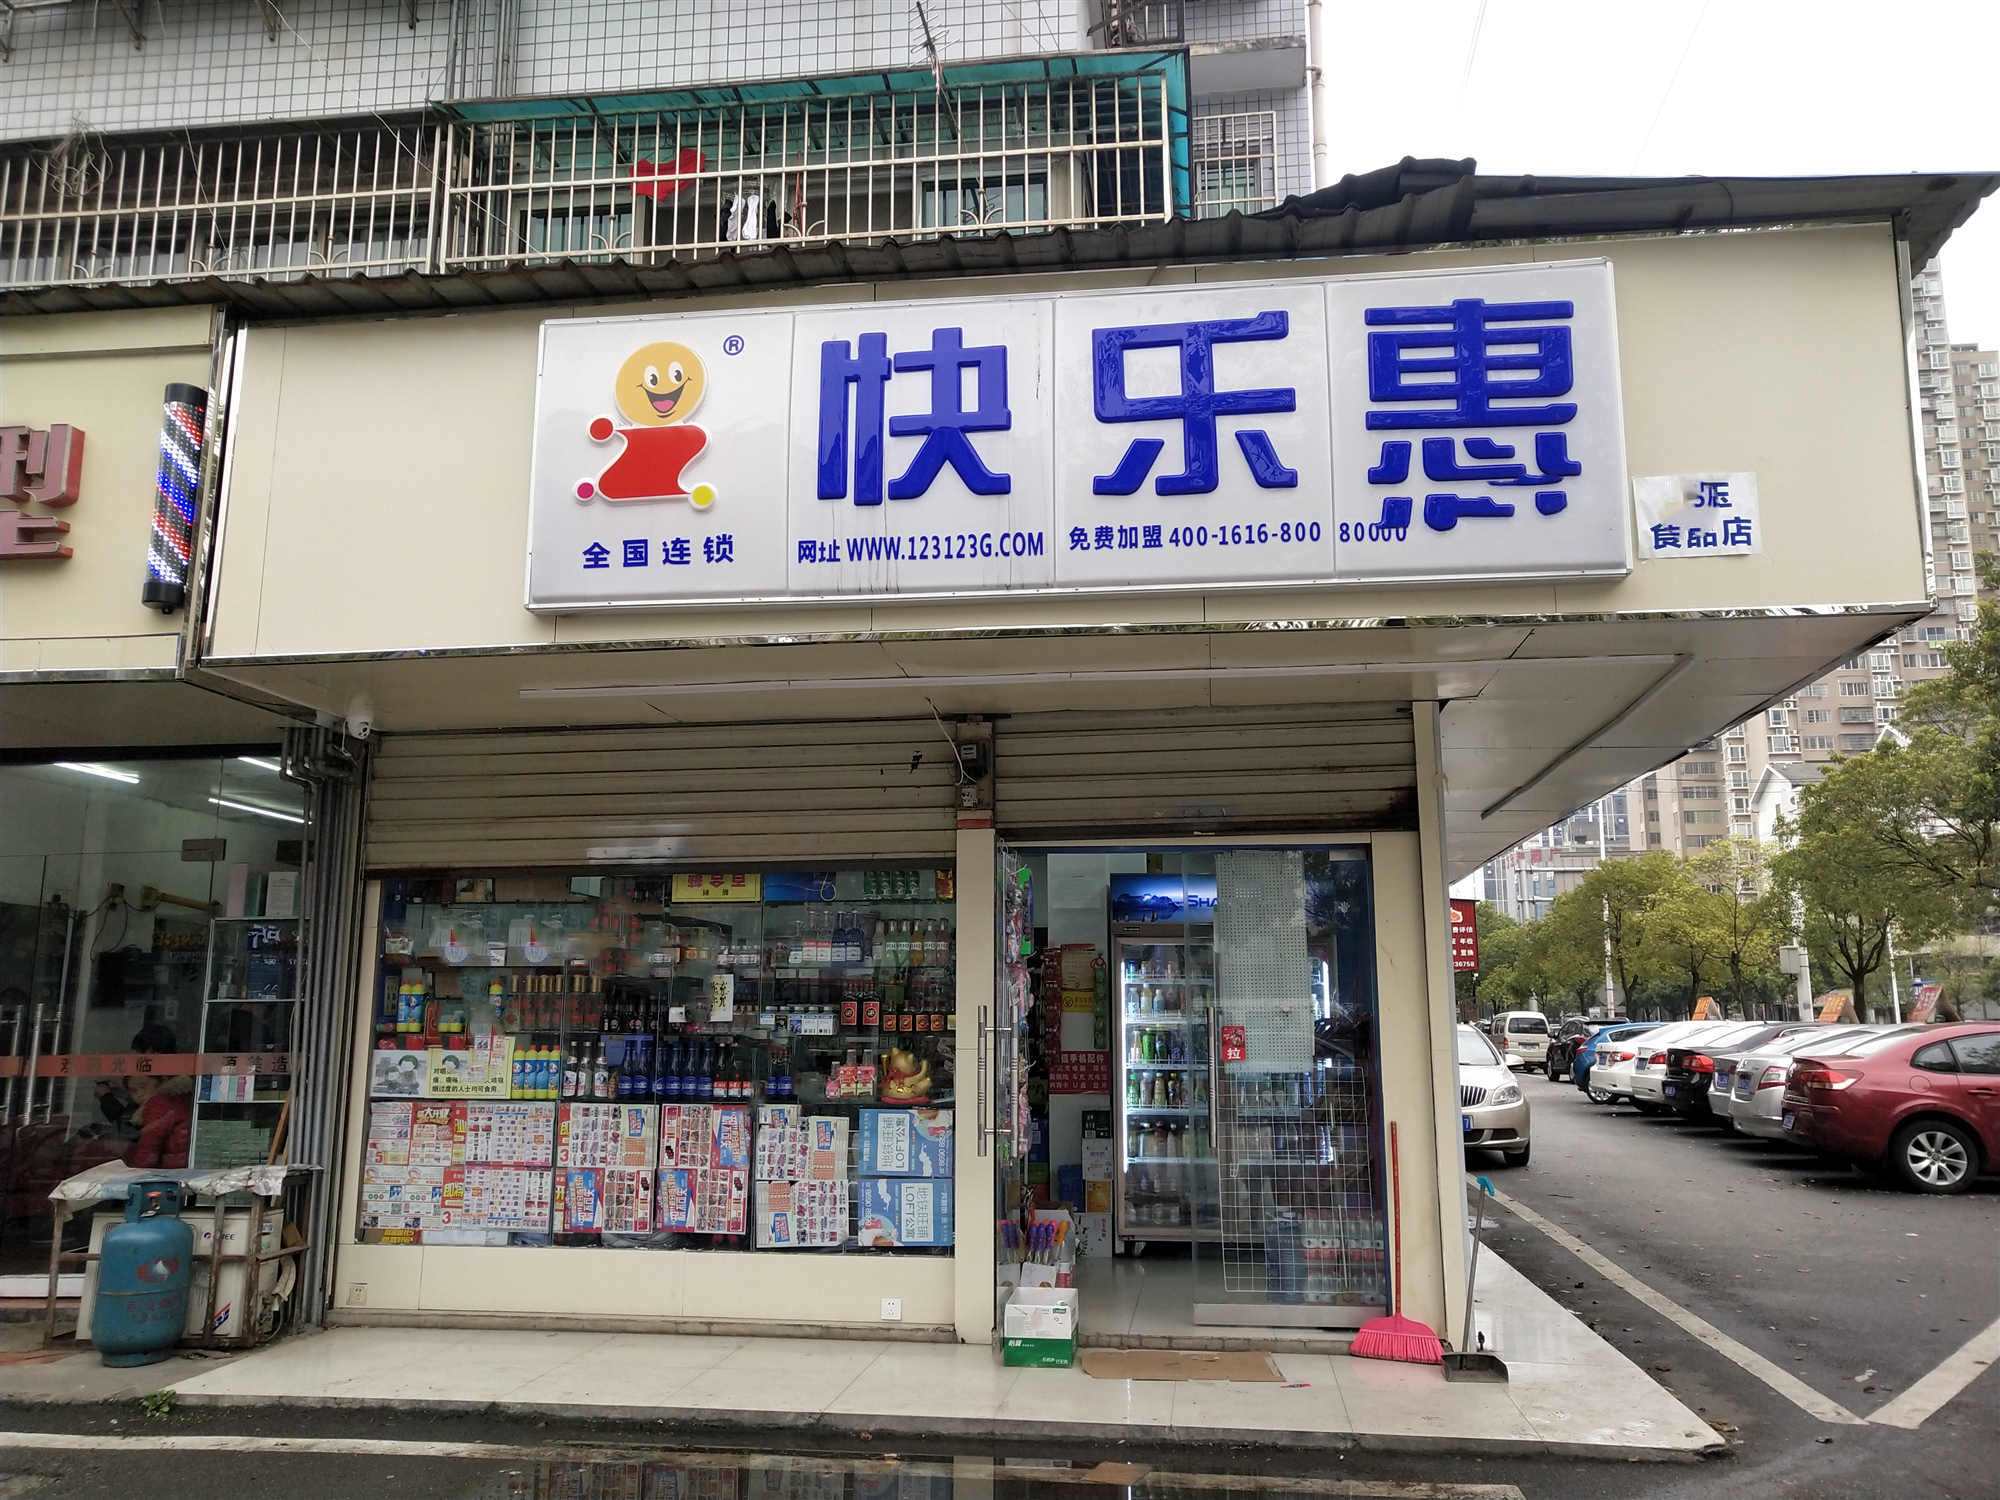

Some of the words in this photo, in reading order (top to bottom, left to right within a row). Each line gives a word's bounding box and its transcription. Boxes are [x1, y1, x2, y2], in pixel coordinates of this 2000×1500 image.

[816, 298, 1582, 532] 快乐惠
[582, 533, 735, 569] 全国连锁
[797, 538, 841, 564] 网址
[846, 531, 1044, 562] WWW.123123G.COM
[1068, 525, 1164, 551] 免费加盟
[1169, 521, 1322, 548] 400-1616-800
[1226, 1047, 1241, 1060] 拉
